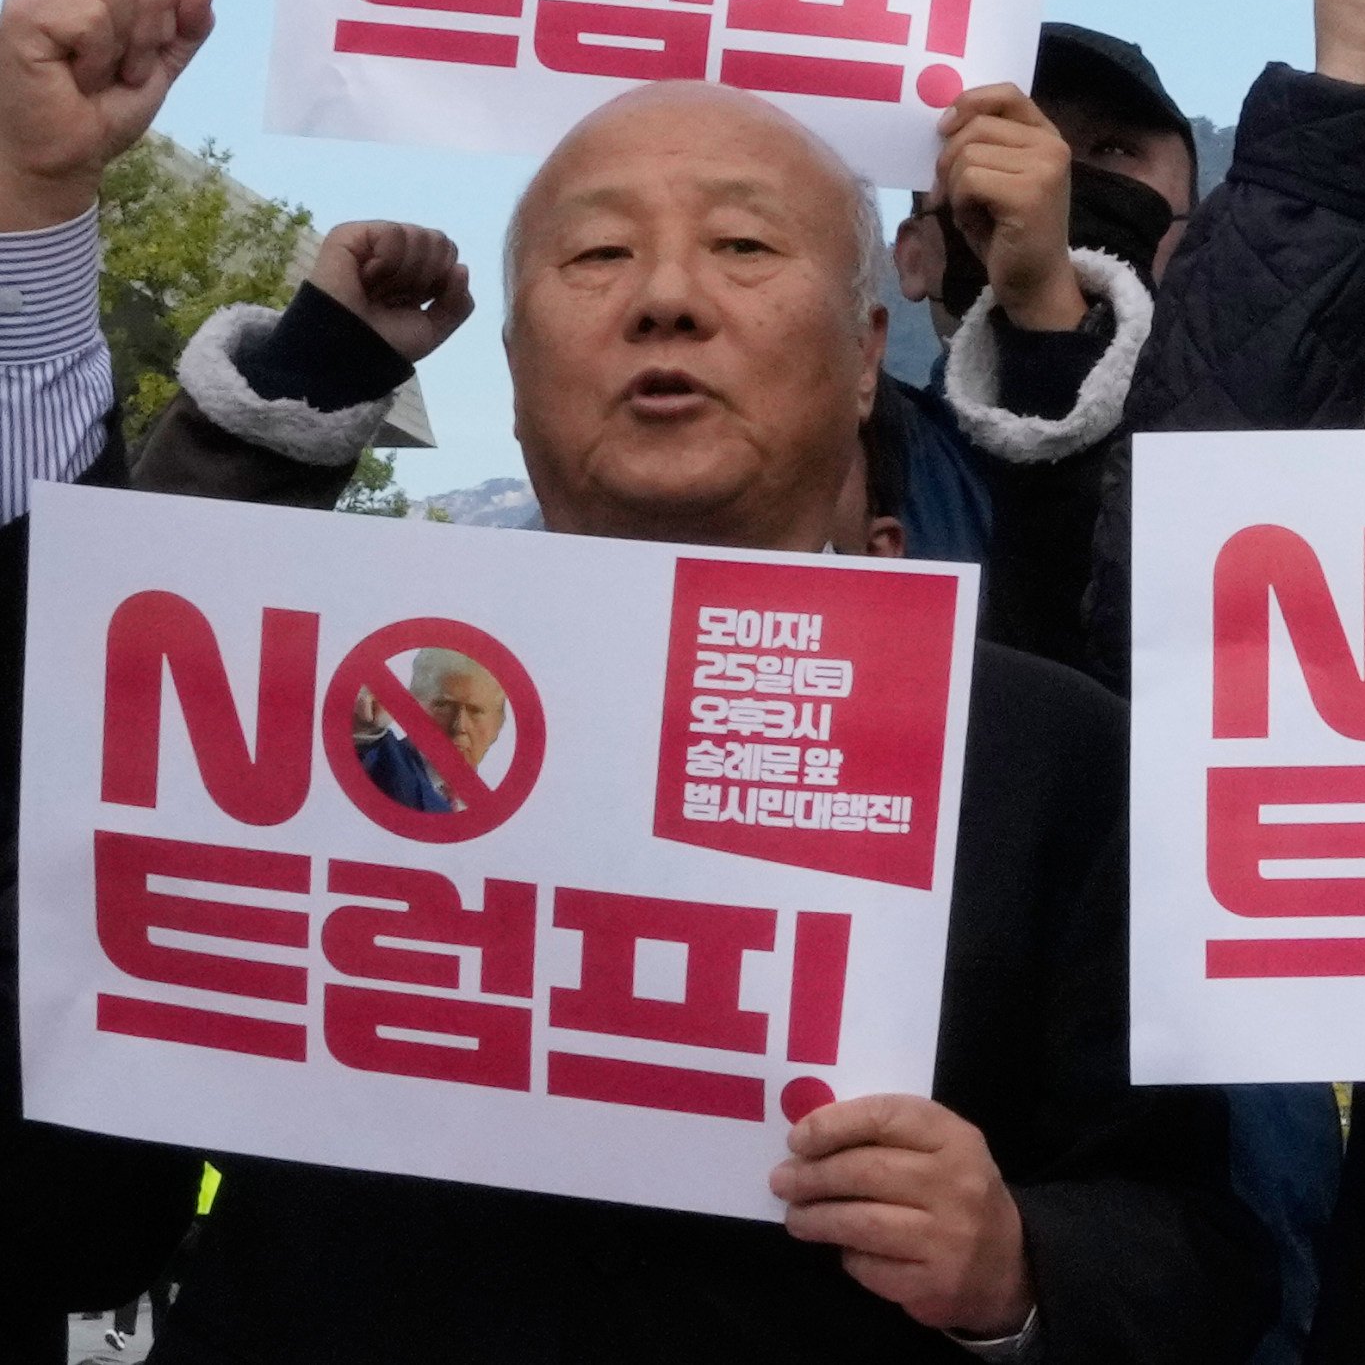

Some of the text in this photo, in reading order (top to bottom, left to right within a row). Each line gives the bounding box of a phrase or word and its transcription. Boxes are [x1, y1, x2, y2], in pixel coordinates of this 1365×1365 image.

[698, 608, 822, 651] 모이자!
[694, 651, 852, 697] 25일(토)
[101, 590, 546, 844] NO
[686, 741, 843, 785] 숭례문 앞
[683, 783, 912, 833] 범시민대행진!
[94, 830, 852, 1125] 트럼프!
